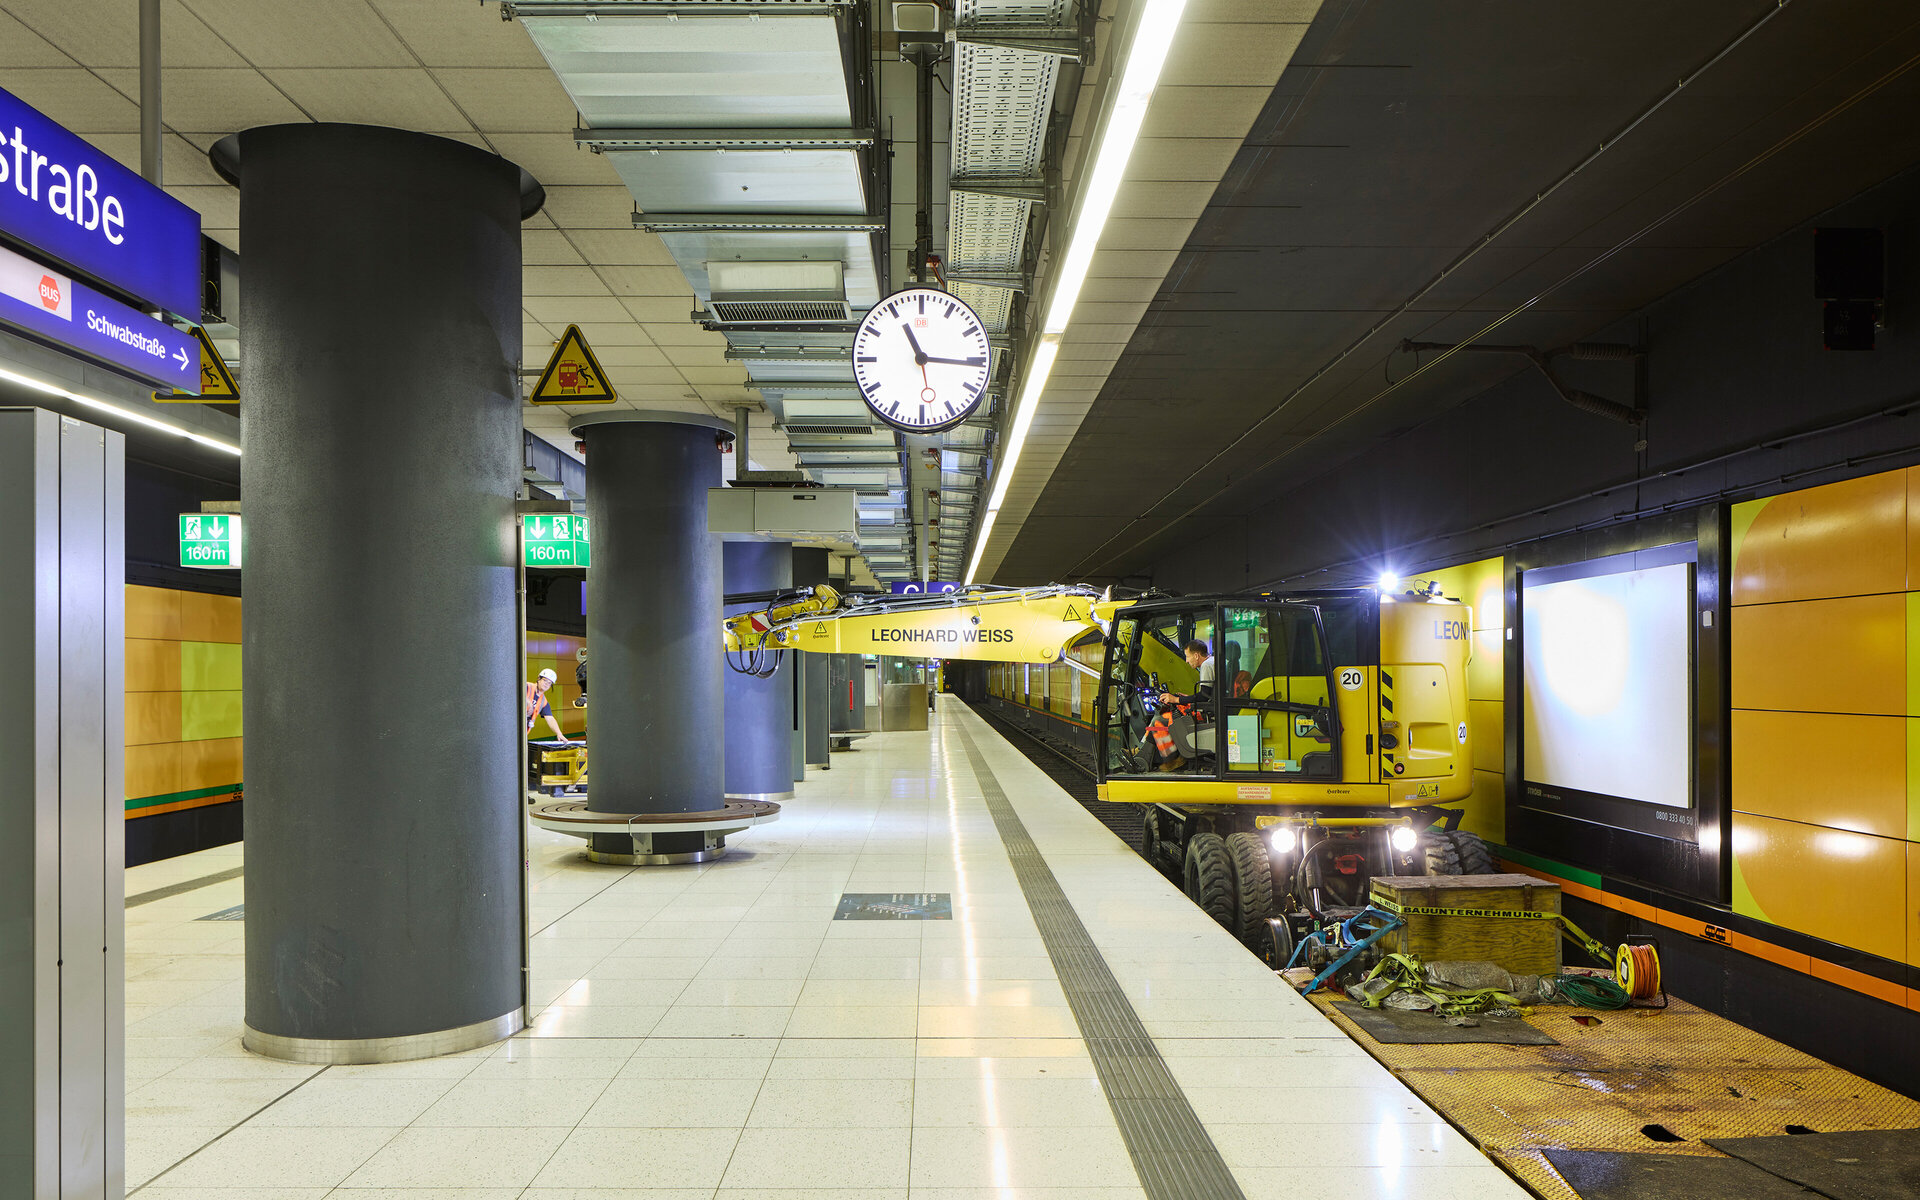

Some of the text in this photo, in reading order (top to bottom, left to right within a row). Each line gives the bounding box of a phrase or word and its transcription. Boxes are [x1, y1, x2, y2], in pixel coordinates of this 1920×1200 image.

[40, 284, 59, 302] BUS
[916, 319, 927, 327] DB
[86, 309, 166, 359] Schwabstraße
[871, 628, 1014, 643] LEONHARD WEISS
[1342, 672, 1361, 685] 20
[1458, 726, 1466, 738] 20
[1655, 810, 1668, 821] 0800
[1668, 812, 1678, 823] 333
[1686, 816, 1694, 826] 50
[1384, 900, 1400, 912] WEISS
[1403, 907, 1543, 918] BAUUNTERNEHMUNG
